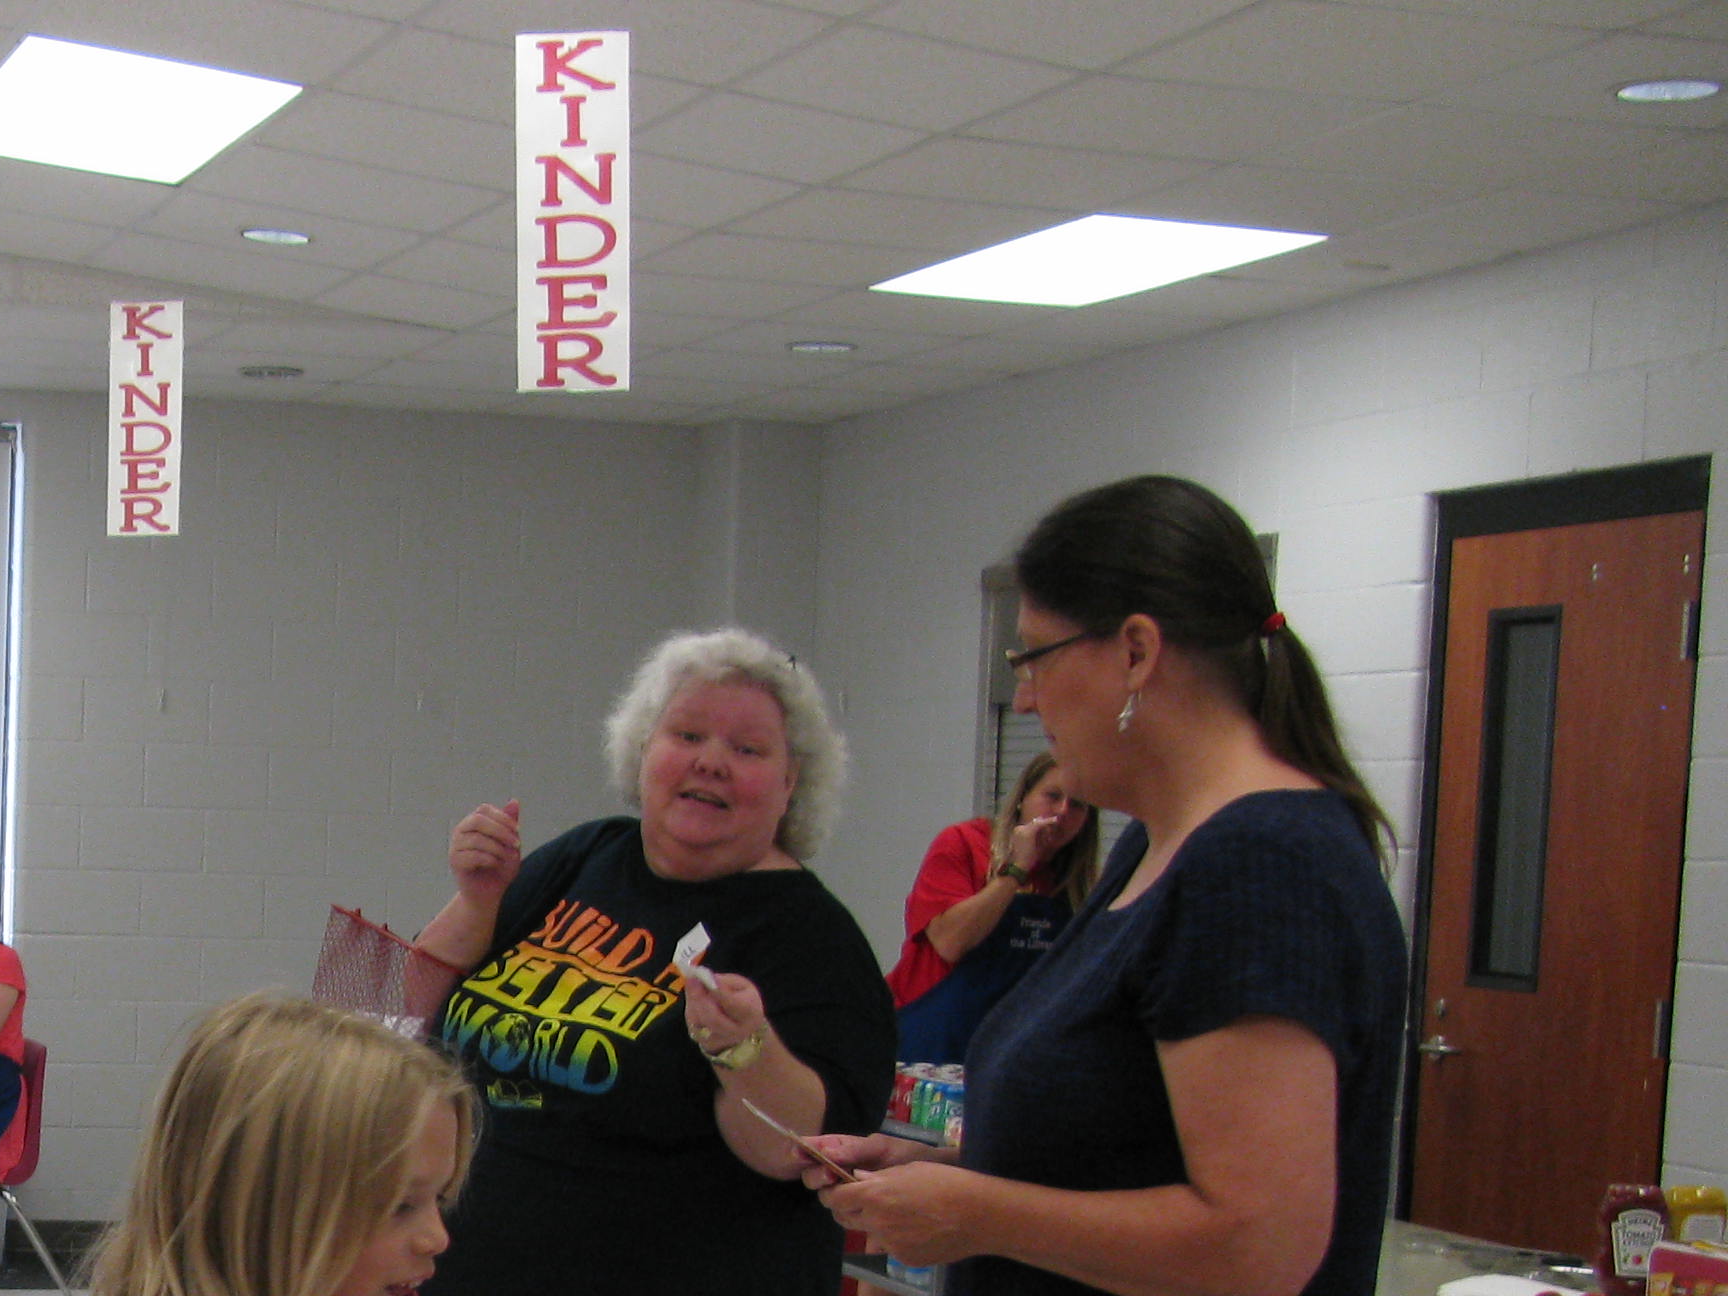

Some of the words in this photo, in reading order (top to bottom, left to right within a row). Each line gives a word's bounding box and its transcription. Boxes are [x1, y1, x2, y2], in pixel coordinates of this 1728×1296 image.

[535, 38, 617, 387] KINDER
[119, 305, 172, 533] KINDER
[442, 990, 618, 1094] WORLD
[462, 941, 678, 1040] BETTER
